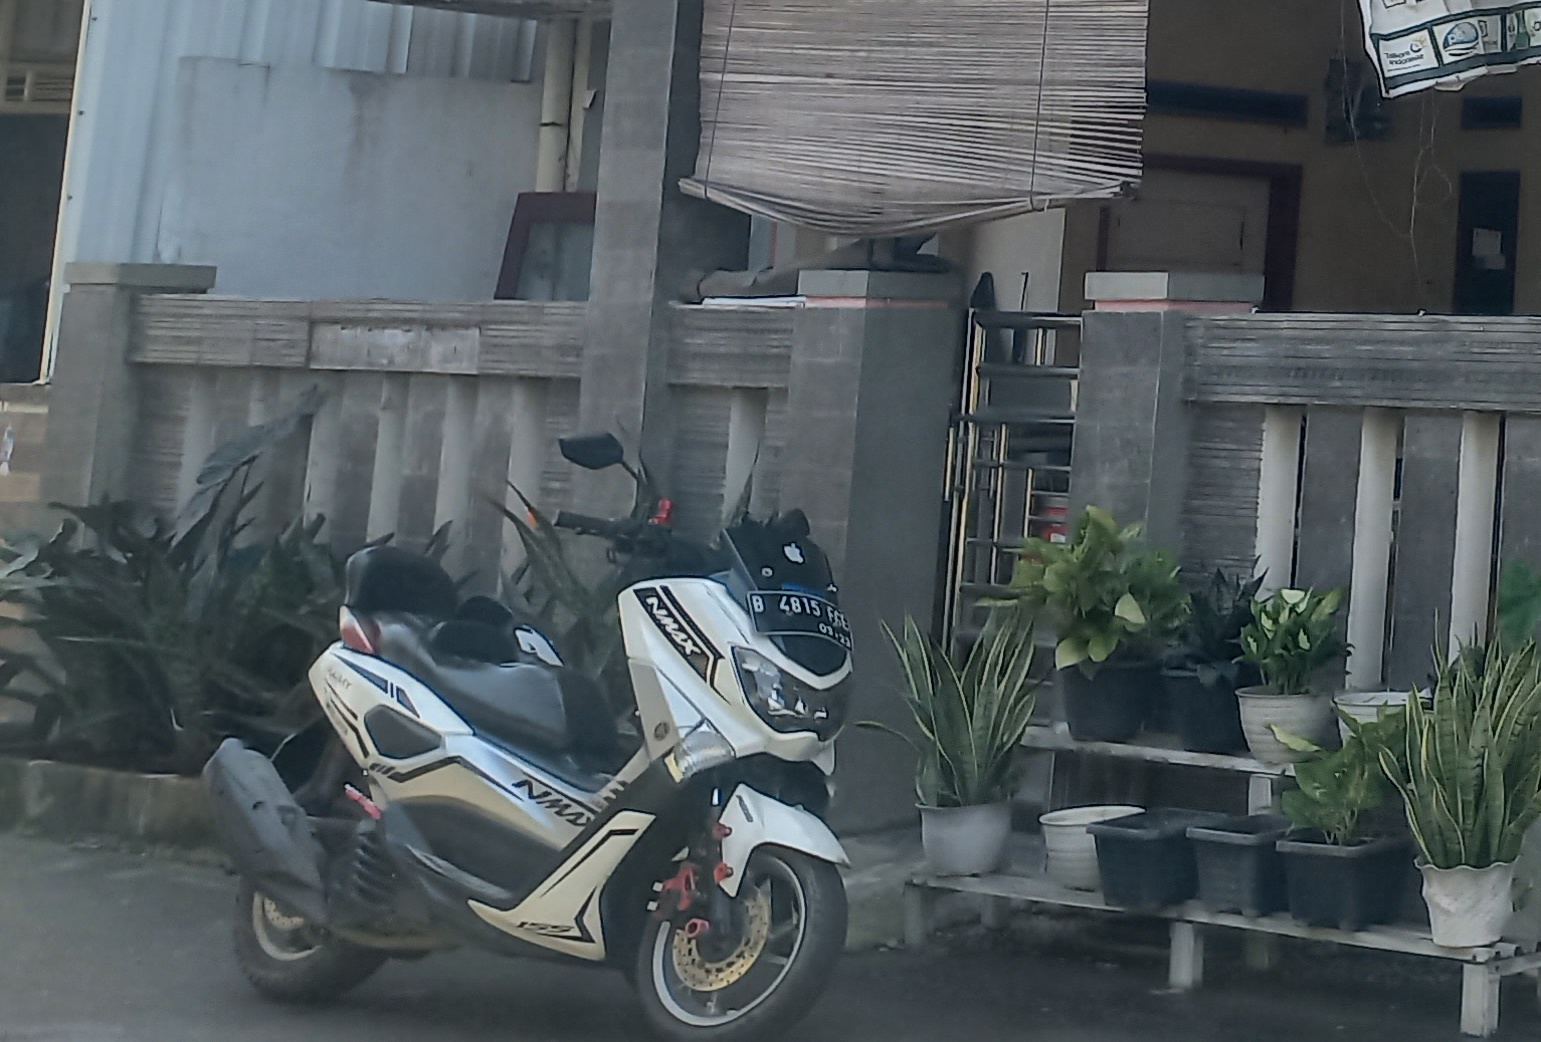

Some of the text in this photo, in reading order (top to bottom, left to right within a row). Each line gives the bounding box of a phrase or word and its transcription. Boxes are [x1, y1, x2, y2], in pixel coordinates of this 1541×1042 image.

[646, 596, 701, 656] NMAX
[752, 595, 764, 613] B
[780, 595, 821, 617] 4815
